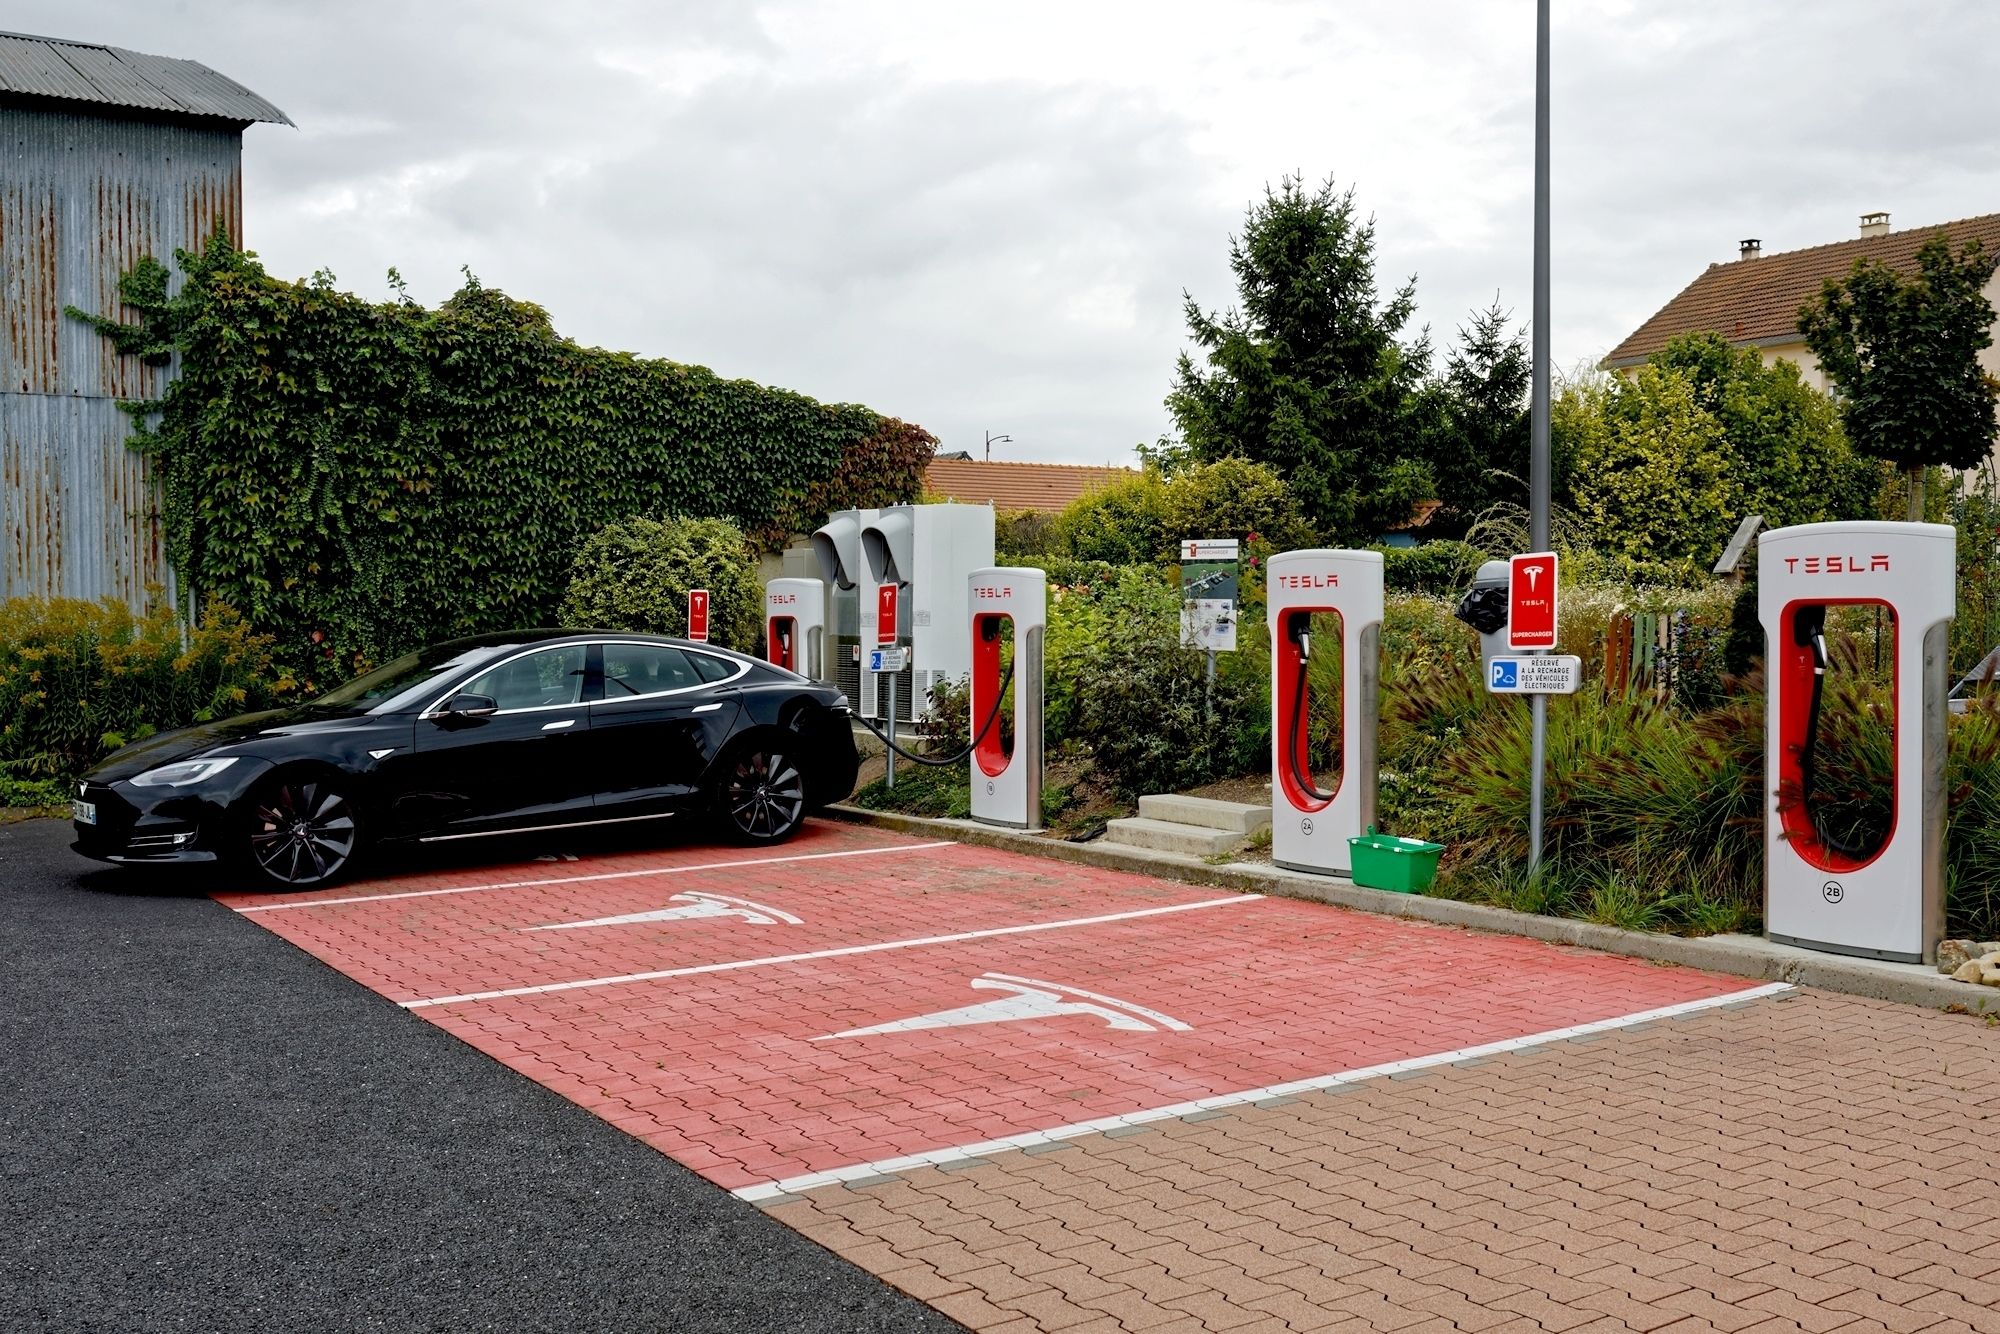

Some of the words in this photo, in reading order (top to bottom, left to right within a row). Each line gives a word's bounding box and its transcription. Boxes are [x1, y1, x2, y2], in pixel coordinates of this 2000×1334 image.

[1783, 555, 1889, 574] TESLA
[1279, 575, 1338, 588] TESLA
[974, 587, 1011, 598] TESLA
[769, 594, 795, 604] TESLA
[1512, 630, 1553, 638] SUPERCHARGER
[1531, 659, 1559, 667] RÉSERVÉ
[1535, 674, 1569, 682] VÉHICULES
[1524, 681, 1565, 690] ÉLECTRIQUES
[1826, 887, 1840, 896] 2B
